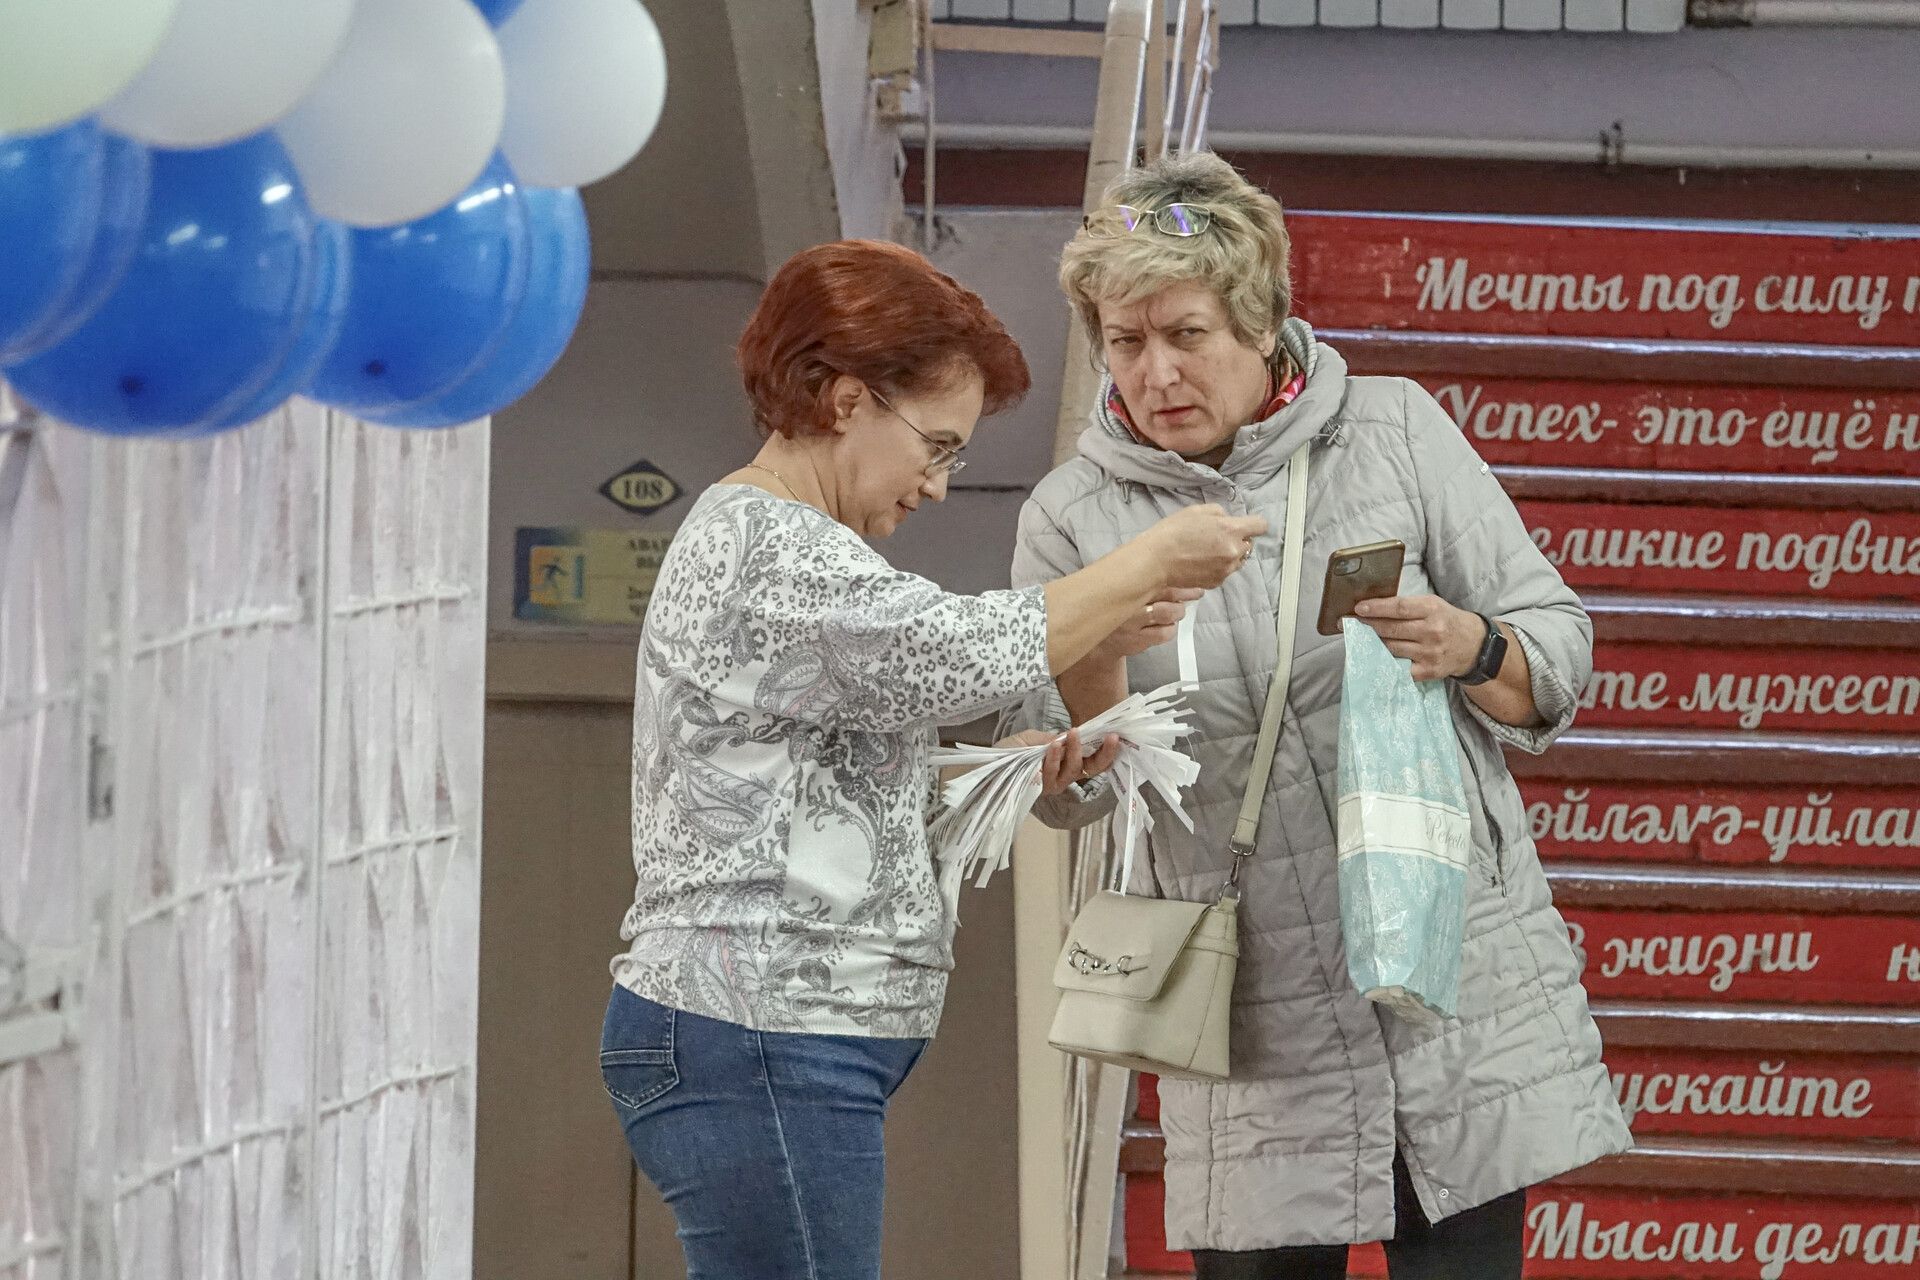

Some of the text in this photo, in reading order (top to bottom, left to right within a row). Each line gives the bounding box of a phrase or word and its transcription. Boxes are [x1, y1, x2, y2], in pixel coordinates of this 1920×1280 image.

[1415, 256, 1630, 313] Мечты
[1637, 273, 1745, 330] под
[1754, 274, 1893, 330] силу
[1433, 384, 1618, 444] Успех-
[1632, 405, 1758, 447] это
[1761, 399, 1884, 466] ещё
[623, 478, 664, 500] 108
[1601, 932, 1819, 992] жизни
[1527, 1200, 1744, 1263] Мысли
